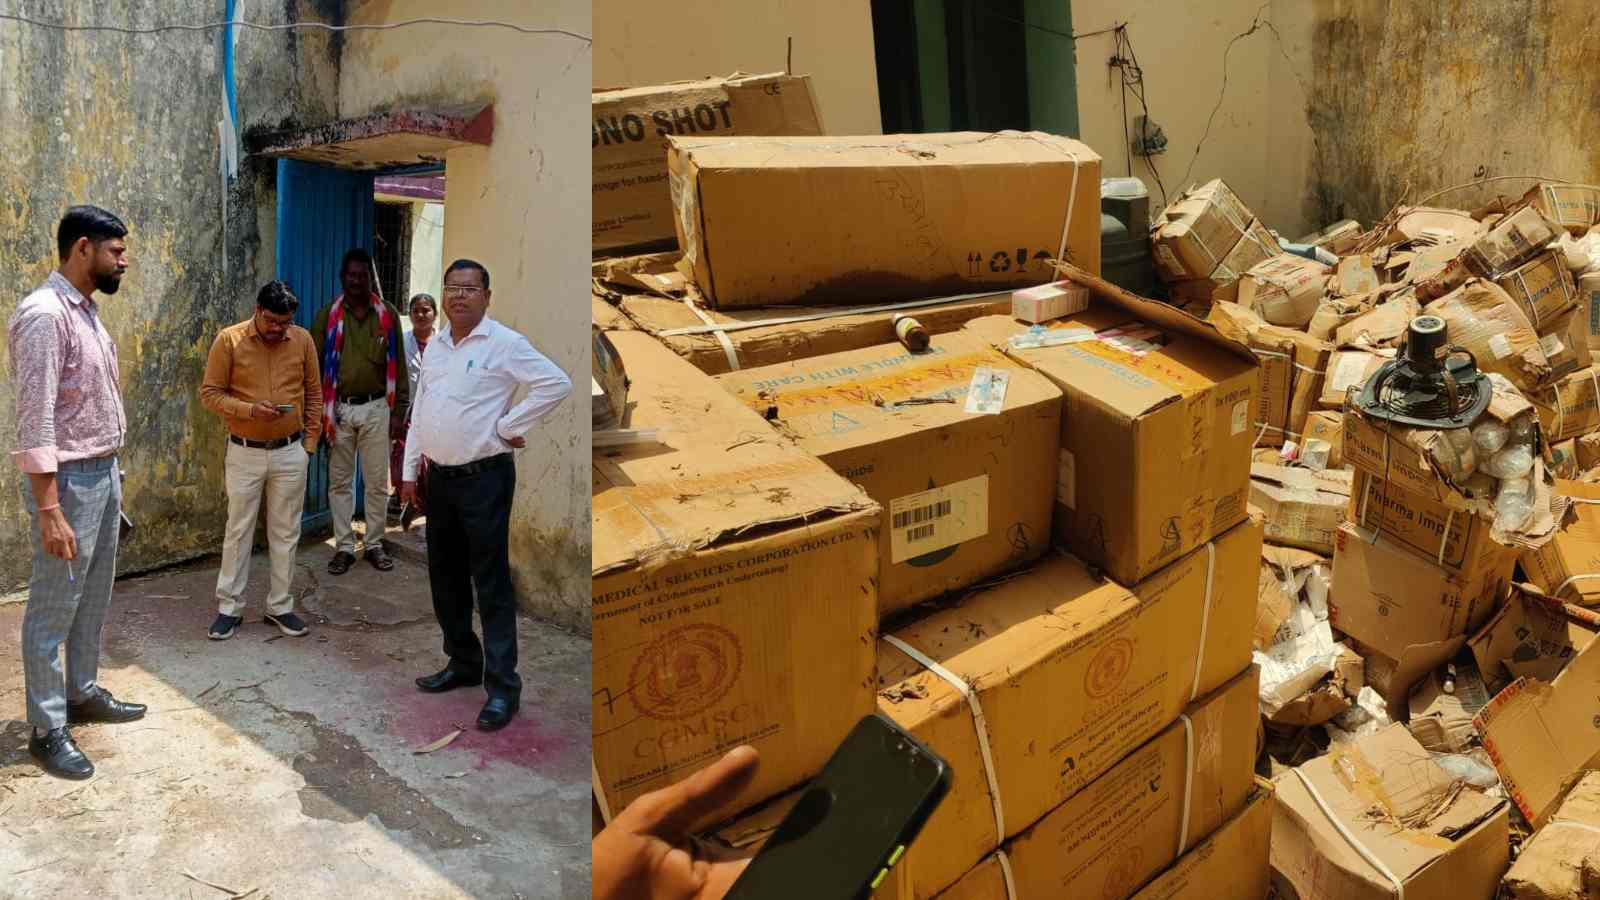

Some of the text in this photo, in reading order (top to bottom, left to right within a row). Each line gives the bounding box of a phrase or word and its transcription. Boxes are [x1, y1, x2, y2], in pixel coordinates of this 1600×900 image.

[652, 101, 733, 136] SHOT
[1369, 485, 1414, 519] Pharma
[592, 580, 660, 607] MEDICAL
[664, 561, 734, 587] SERVICES
[736, 538, 830, 570] CORPORATION
[640, 596, 721, 625] NOT FOR SALE
